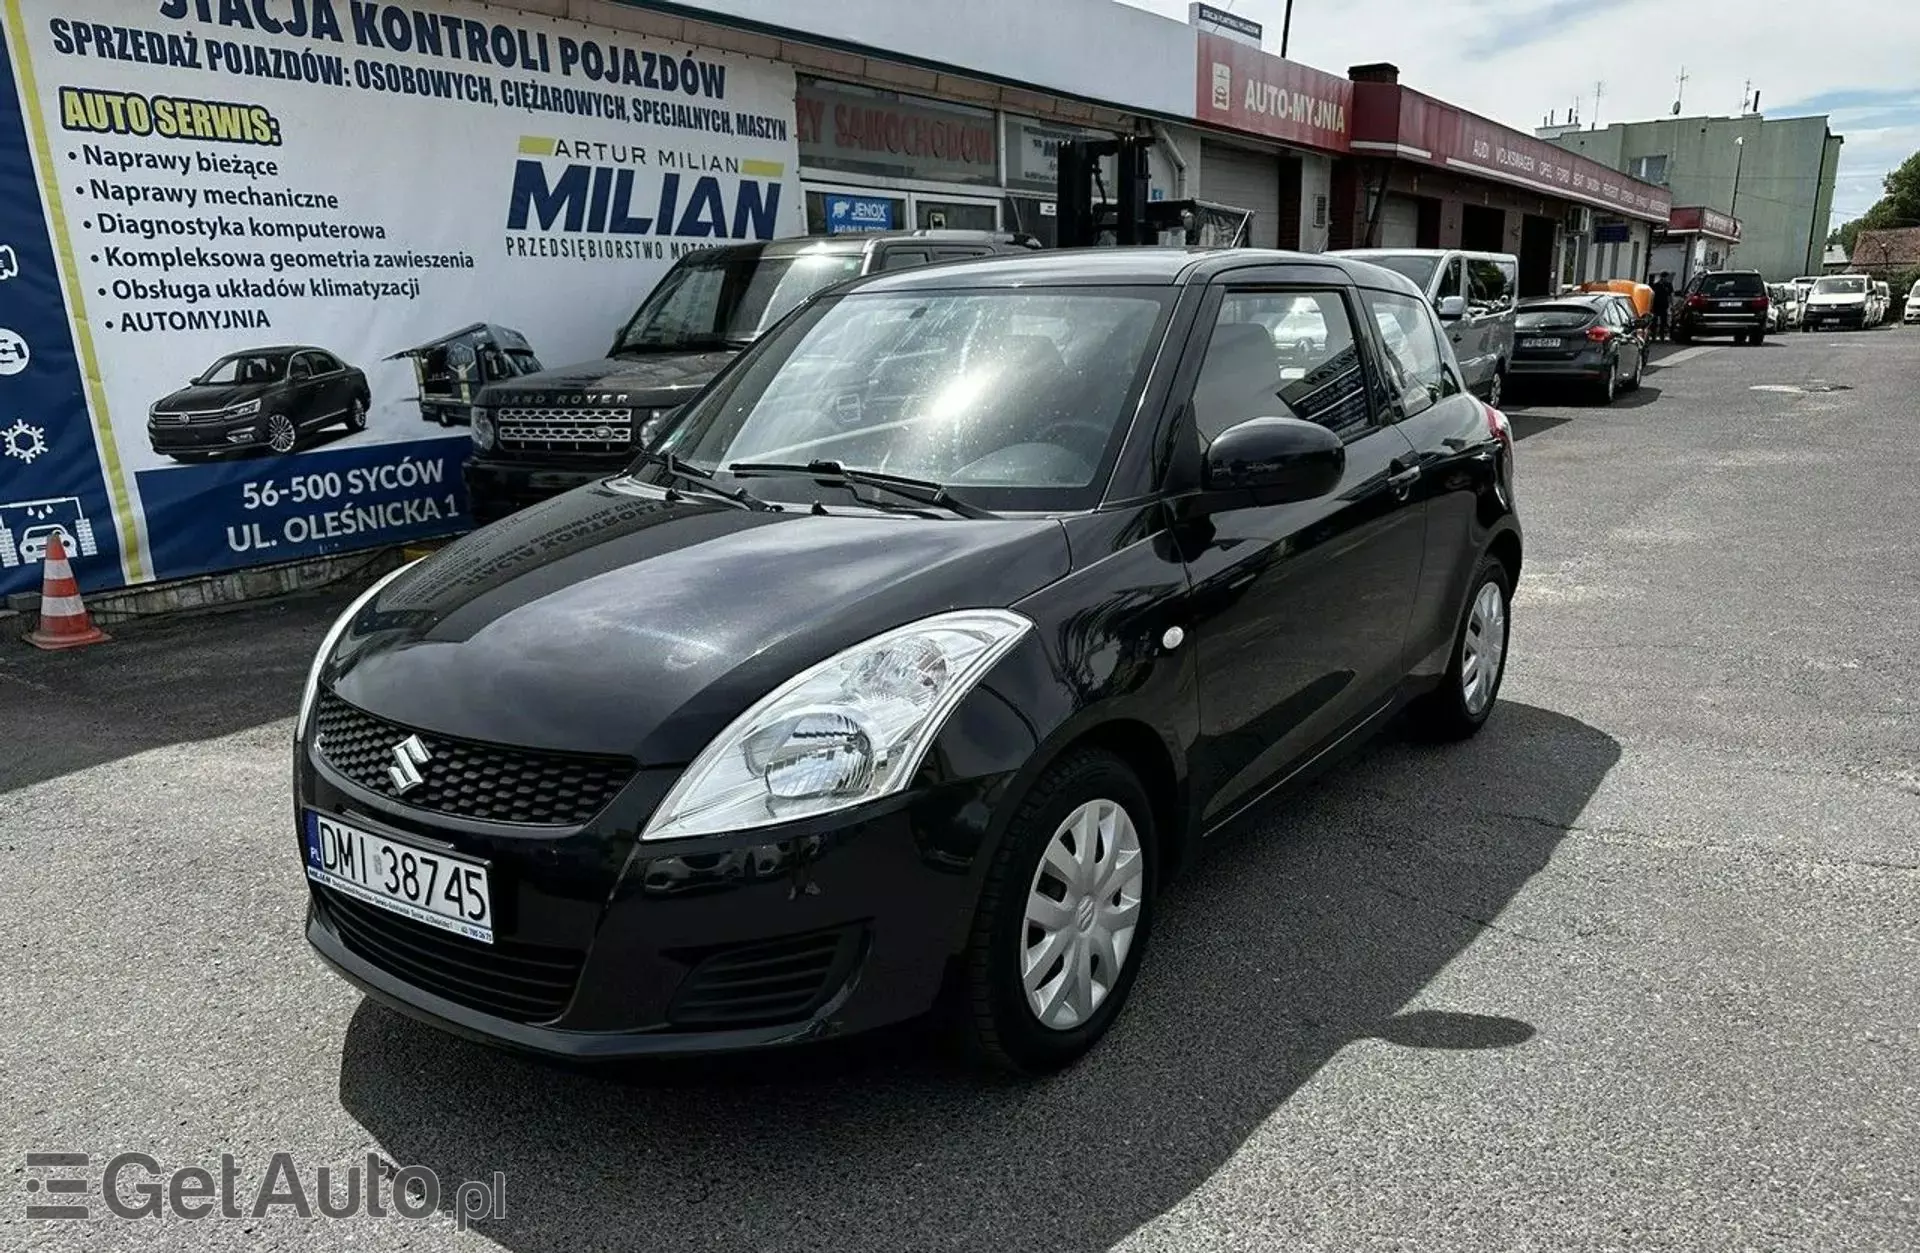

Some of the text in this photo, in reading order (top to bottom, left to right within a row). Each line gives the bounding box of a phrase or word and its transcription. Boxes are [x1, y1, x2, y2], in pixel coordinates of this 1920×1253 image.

[350, 1, 551, 73] KONTROLI
[559, 37, 726, 99] POJAZDÓW
[50, 18, 787, 141] SPRZEDAŻ POJAZDÓW: OSOBOWYCH, CIĘŻAROWYCH, SPECJALNYCH, MASZYN
[59, 87, 282, 146] AUTO SERWIS:
[1244, 79, 1345, 133] AUTO-MYJNIA
[83, 143, 279, 178] Naprawy bieżące
[555, 139, 739, 174] ARTUR MILIAN
[90, 178, 339, 209] Naprawy mechaniczne
[507, 159, 782, 240] MILIAN
[851, 202, 886, 219] JENOX
[97, 214, 386, 242] Diagnostyka komputerowa
[105, 246, 474, 273] Kompleksowa geometria zawieszenia
[506, 236, 663, 261] PRZEDSIĘBIORSTWO
[112, 278, 420, 303] Obsługa układów klimatyzacji
[121, 309, 270, 333] AUTOMYJNIA
[556, 394, 629, 404] ROVER
[242, 458, 444, 509] 56-500 SYCÓW
[227, 498, 460, 553] UL. OLEŚNICKA 1
[320, 821, 367, 884] DMI
[381, 845, 487, 921] 38745
